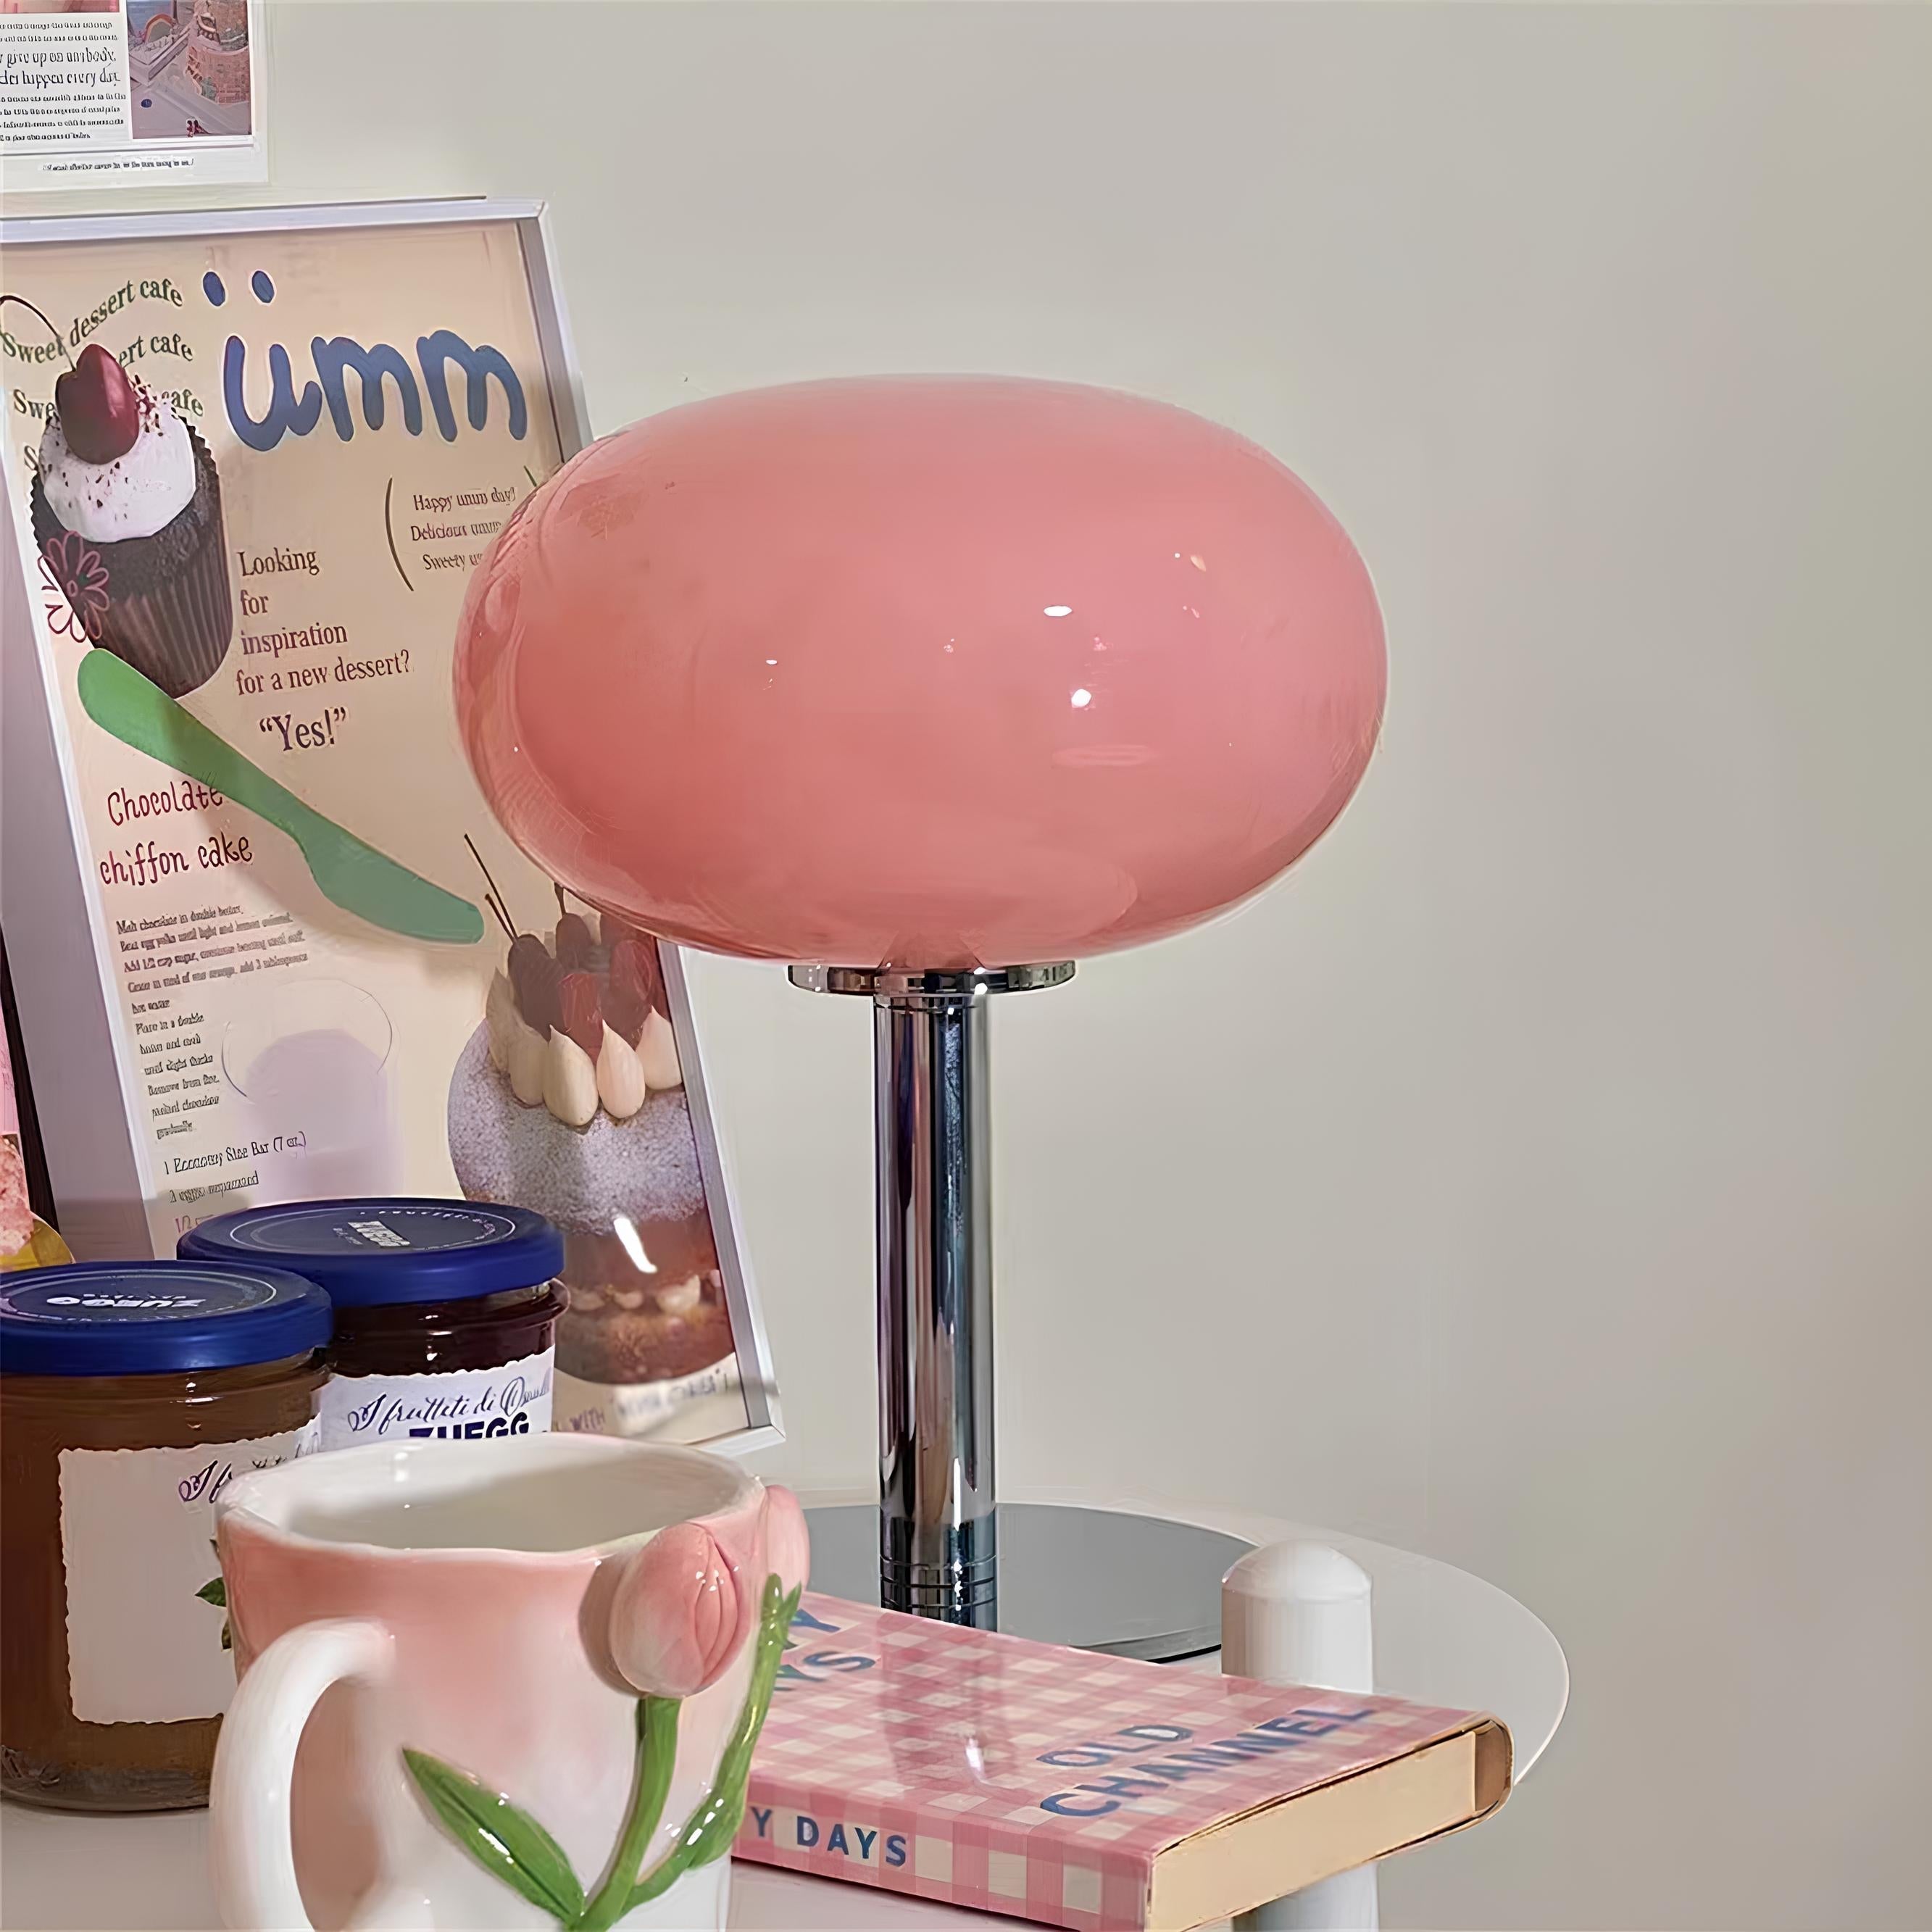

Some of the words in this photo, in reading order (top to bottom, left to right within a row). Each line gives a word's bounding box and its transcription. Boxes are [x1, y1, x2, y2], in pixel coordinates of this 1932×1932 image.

[1, 331, 64, 364] Sweet
[70, 280, 136, 346] dessert
[140, 278, 183, 307] cafe
[151, 333, 193, 361] cafe
[413, 494, 453, 513] Happy
[237, 547, 320, 577] Looking
[240, 590, 268, 616] for
[241, 623, 348, 658] inspiration
[236, 670, 264, 696] for
[272, 673, 283, 691] a
[288, 665, 328, 688] new
[334, 649, 409, 683] dessert?
[107, 780, 223, 826] Chocolate
[99, 841, 189, 886] chiffon
[198, 831, 253, 870] cake
[1036, 1725, 1193, 1767] OLD
[1040, 1709, 1376, 1817] CHANNEL
[796, 1815, 907, 1868] DAYS
